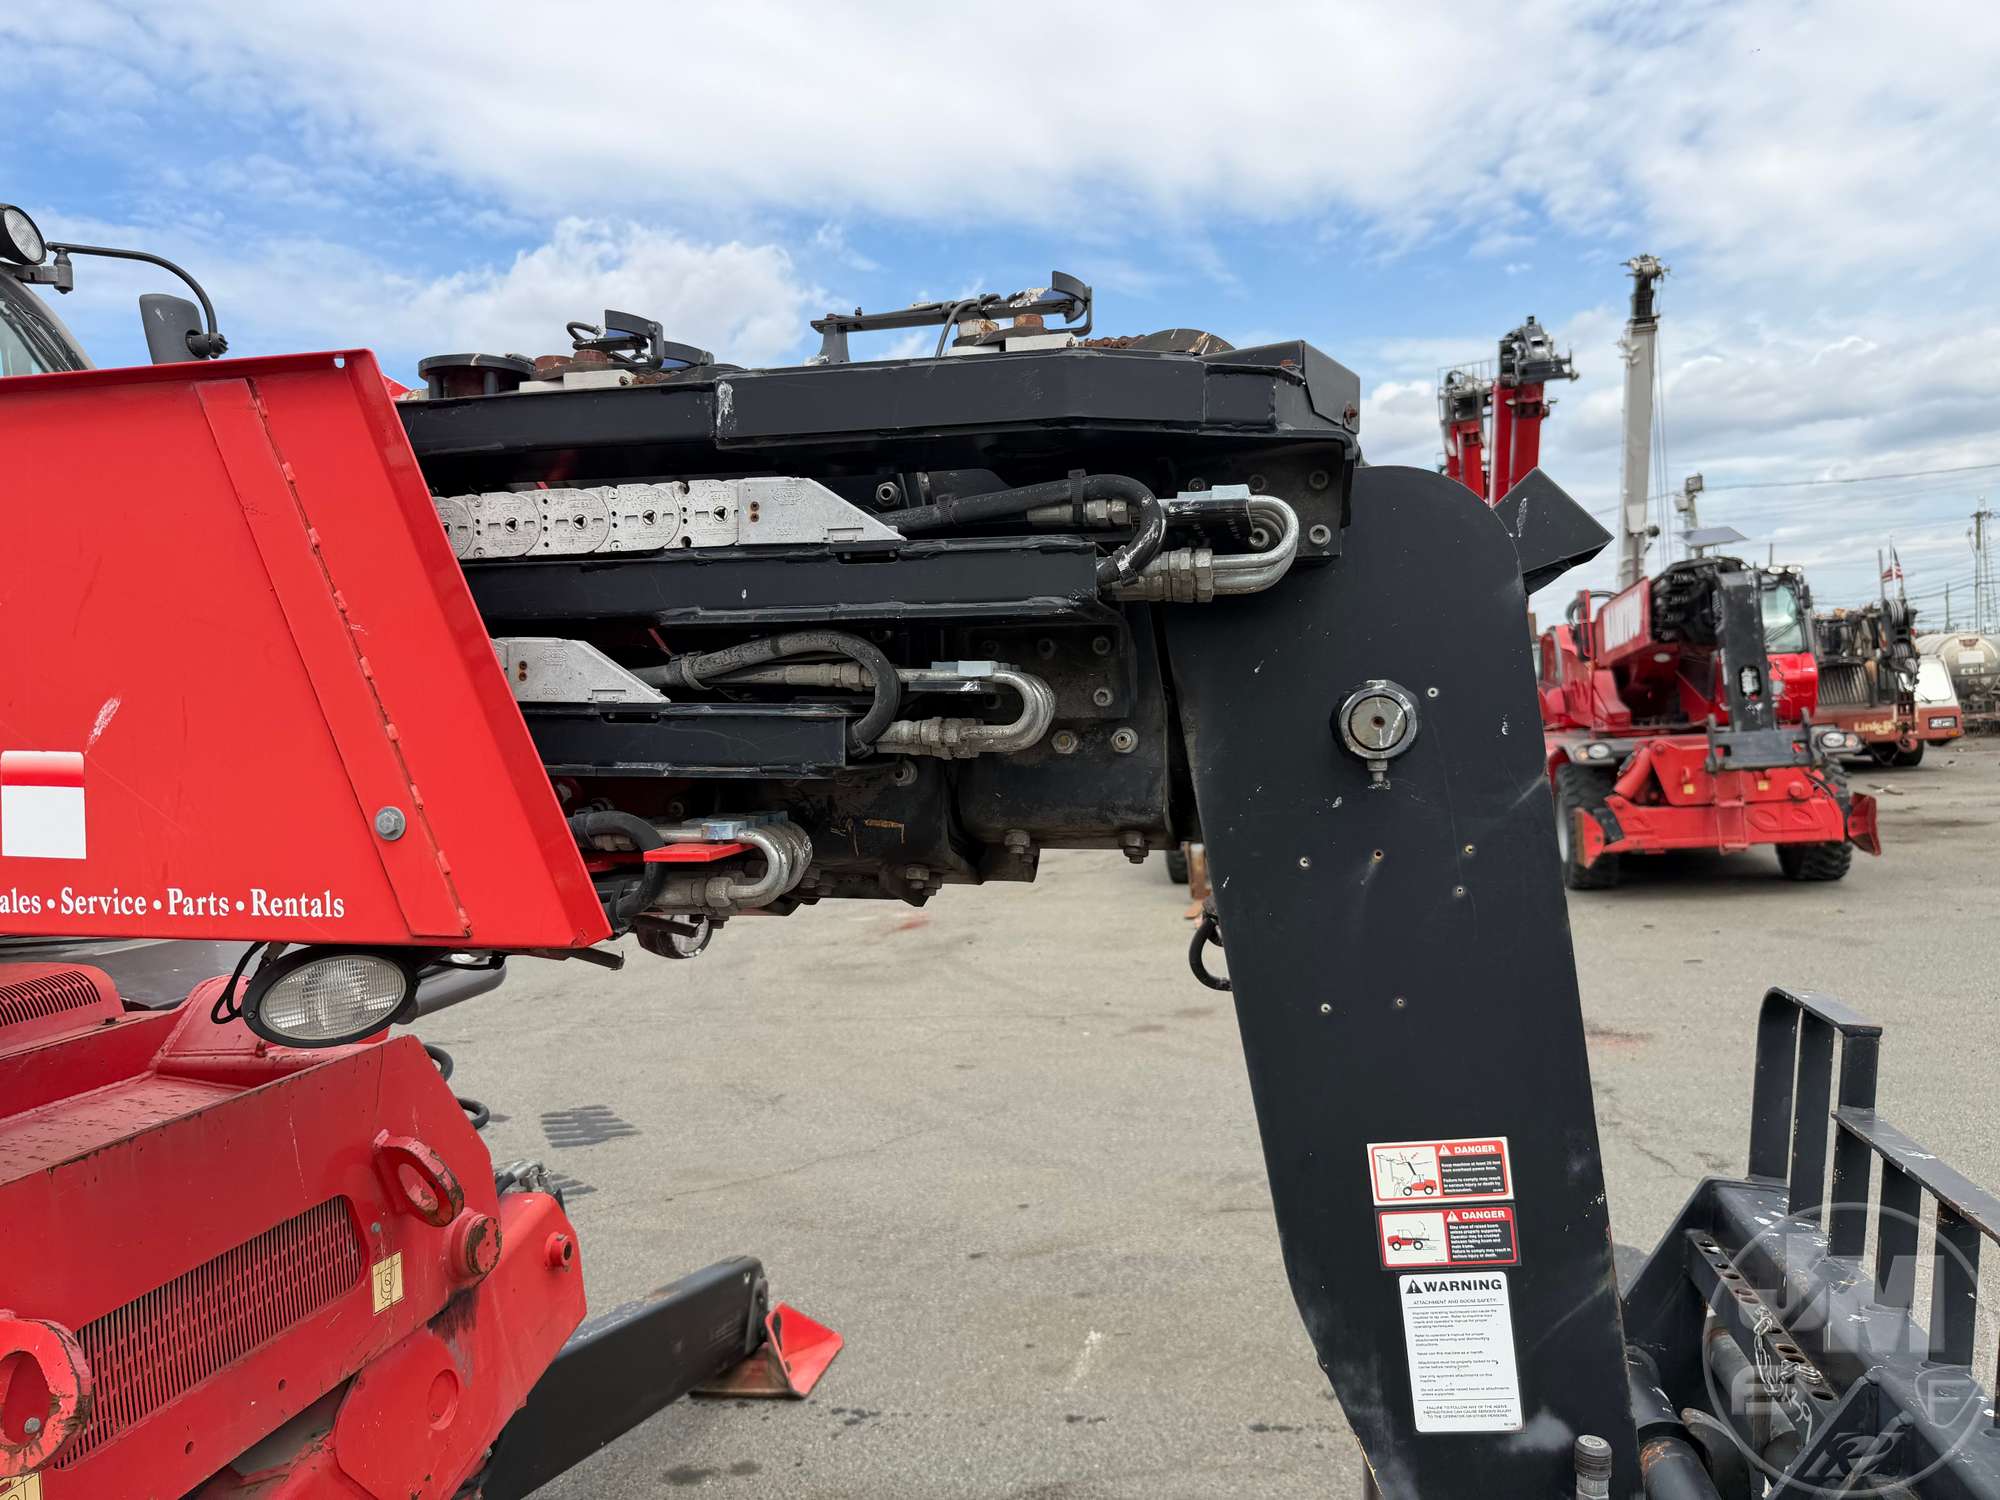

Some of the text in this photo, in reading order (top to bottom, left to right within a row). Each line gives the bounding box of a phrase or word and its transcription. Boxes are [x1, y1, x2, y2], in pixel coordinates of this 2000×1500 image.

[61, 887, 147, 916] Service
[167, 888, 230, 916] Parts
[250, 888, 345, 918] Rentals
[1454, 1145, 1496, 1153] DANGER
[1462, 1211, 1505, 1219] DANGER
[1423, 1279, 1502, 1292] WARNING
